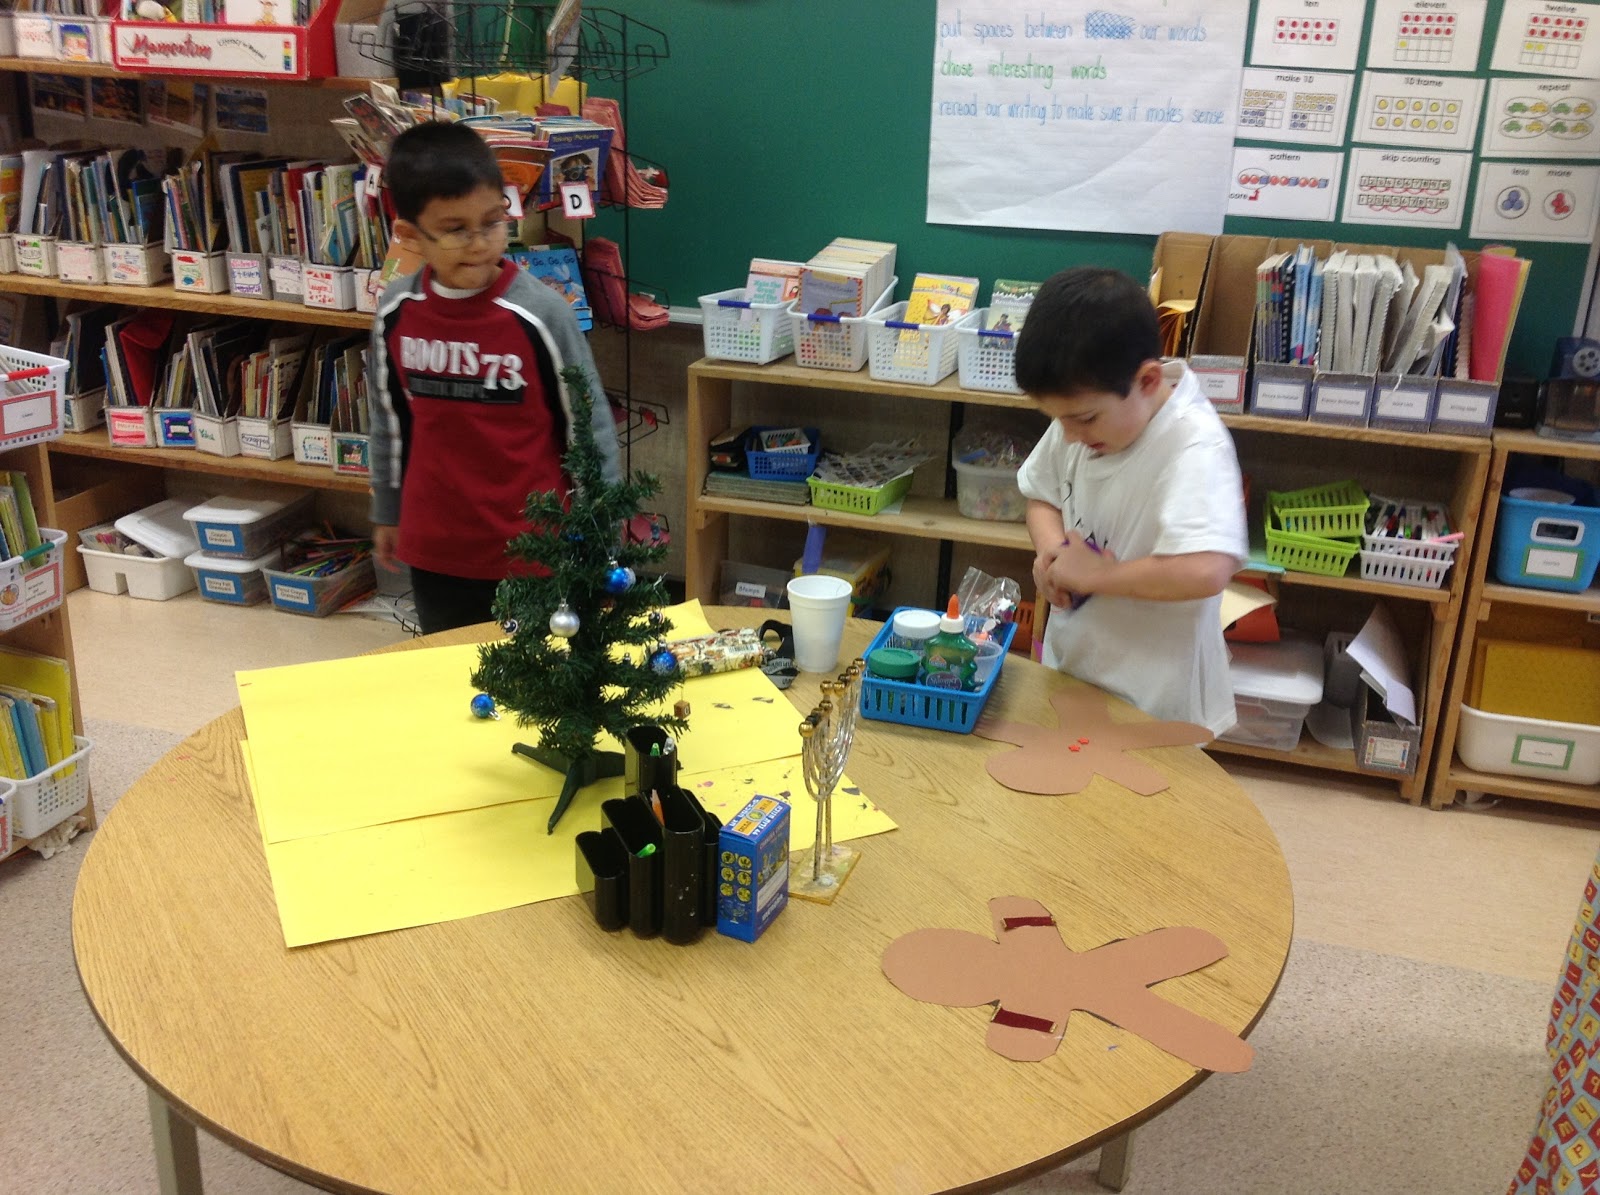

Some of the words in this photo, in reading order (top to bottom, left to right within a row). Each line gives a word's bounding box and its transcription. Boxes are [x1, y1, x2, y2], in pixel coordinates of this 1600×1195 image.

[1414, 1, 1447, 10] eleven
[1544, 4, 1576, 14] twelve
[940, 9, 962, 47] put
[973, 20, 1014, 45] spaces
[1025, 12, 1072, 41] between
[1140, 20, 1161, 41] our
[1167, 14, 1207, 42] words
[940, 49, 974, 78] chose
[988, 50, 1054, 89] interesting
[1071, 54, 1108, 80] words
[1274, 74, 1301, 84] make
[1302, 75, 1315, 84] 10
[1404, 78, 1415, 87] 10
[1417, 78, 1444, 88] frame
[1537, 82, 1572, 93] repeat
[939, 93, 978, 117] reread
[985, 102, 1001, 116] our
[1008, 97, 1046, 125] writing
[1052, 93, 1063, 119] to
[1066, 94, 1094, 120] make
[1100, 104, 1123, 122] sure
[1128, 98, 1138, 122] it
[1146, 97, 1184, 123] makes
[1192, 107, 1225, 125] sense
[1269, 152, 1302, 163] pattern
[1380, 154, 1398, 165] skip
[1400, 155, 1442, 166] counting
[1547, 169, 1573, 178] more
[570, 194, 582, 209] D
[563, 255, 576, 264] Go
[480, 353, 528, 391] 73
